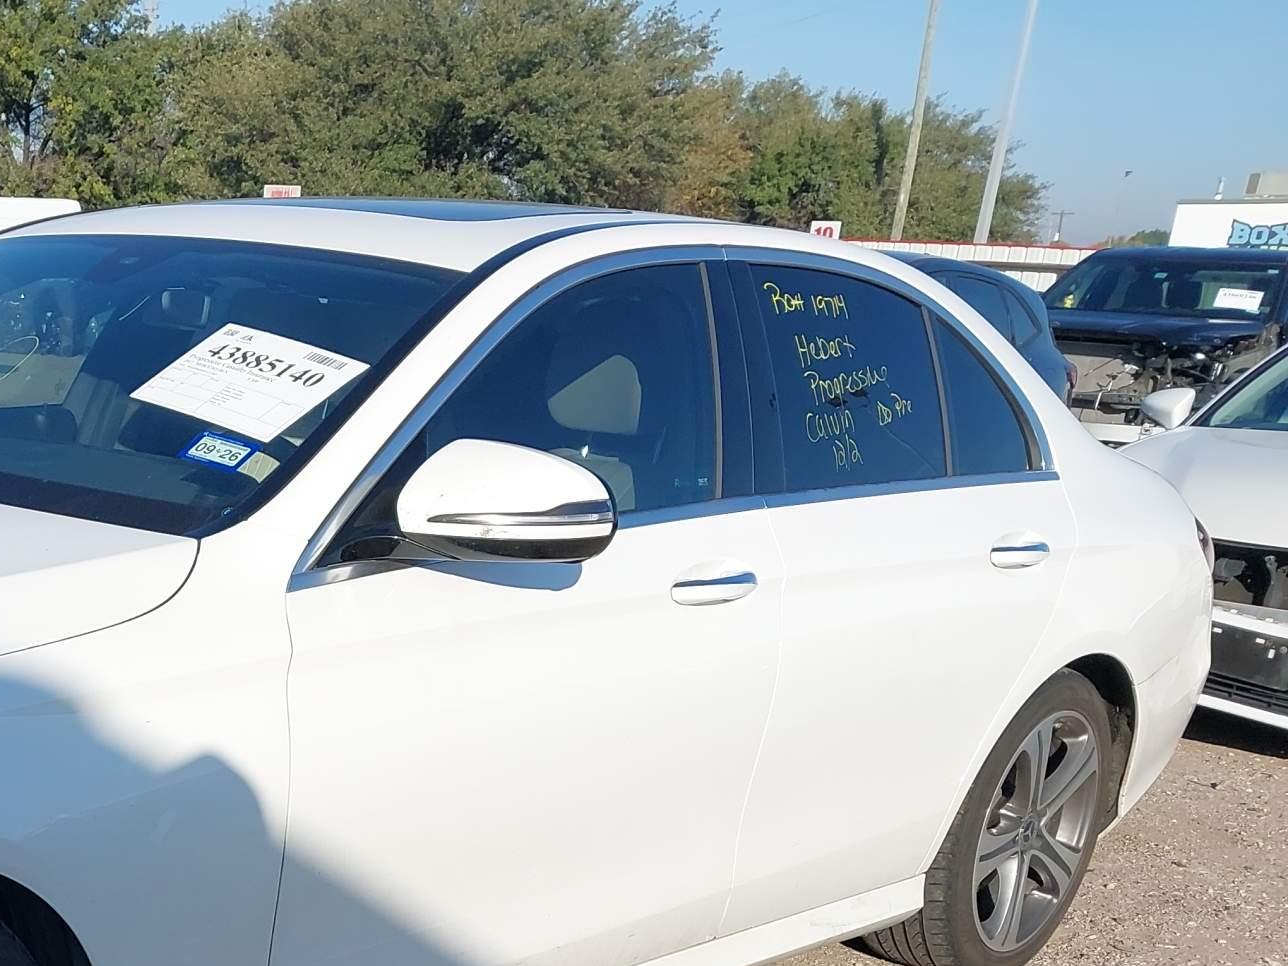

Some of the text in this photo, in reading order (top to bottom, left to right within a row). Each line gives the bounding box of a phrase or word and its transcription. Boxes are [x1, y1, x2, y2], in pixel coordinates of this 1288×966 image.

[208, 343, 327, 388] 43885140
[195, 442, 216, 455] 09
[218, 448, 242, 462] 26
